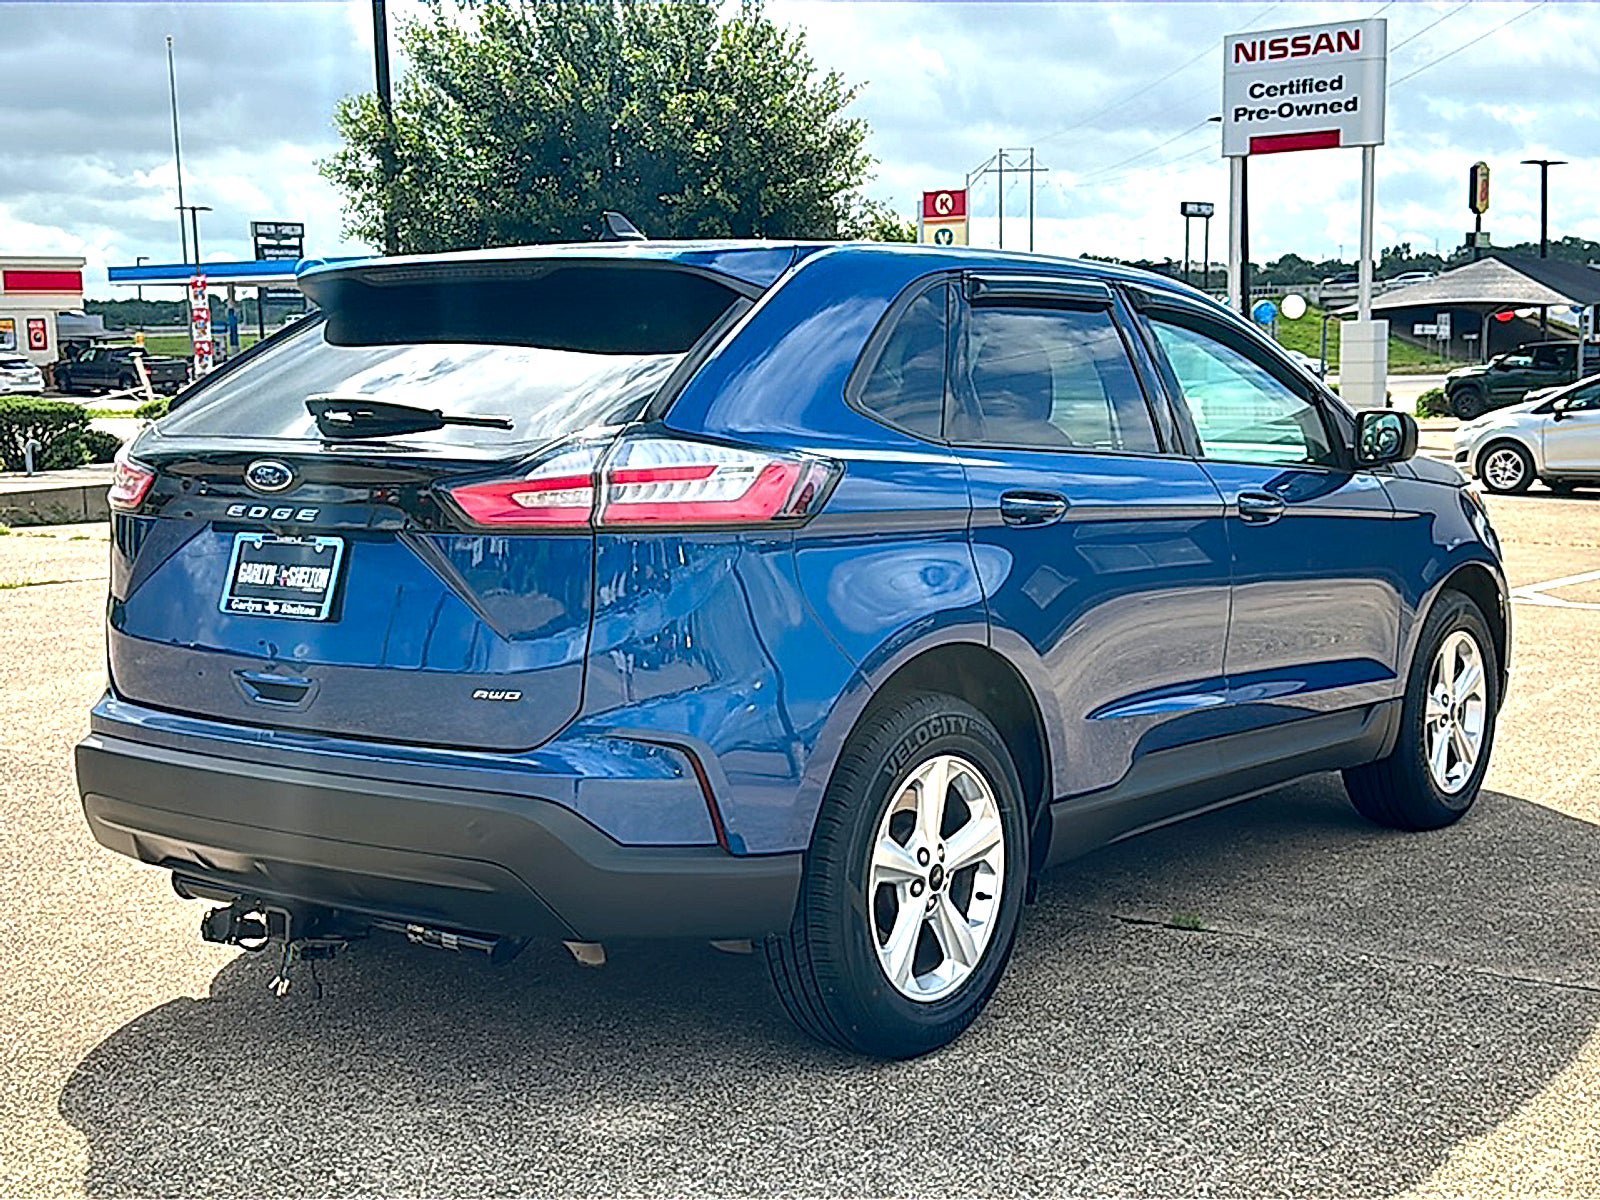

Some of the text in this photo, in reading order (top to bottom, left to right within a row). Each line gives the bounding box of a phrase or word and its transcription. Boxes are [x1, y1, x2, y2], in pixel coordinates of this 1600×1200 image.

[1234, 29, 1361, 64] NISSAN
[1249, 75, 1343, 98] Certified
[1234, 97, 1358, 122] Pre-Owned
[939, 197, 953, 213] K
[226, 504, 320, 521] EDGE
[238, 562, 331, 588] GARLYN SHELTON
[472, 689, 522, 700] AWD
[883, 716, 968, 777] VELOCITY
